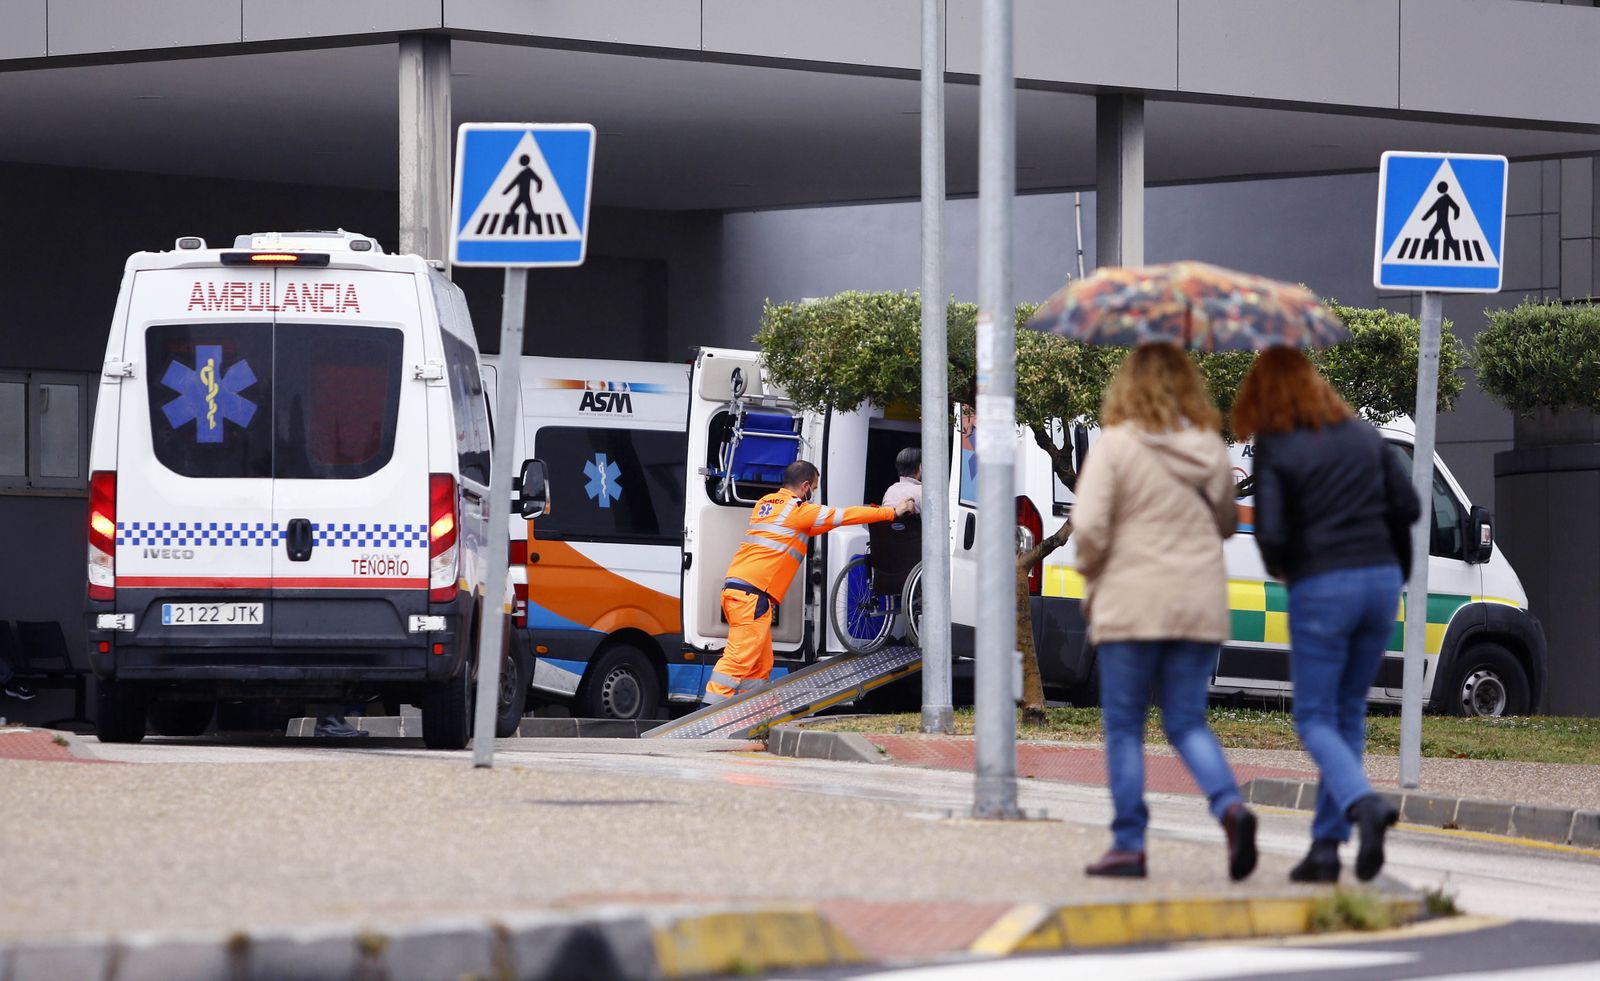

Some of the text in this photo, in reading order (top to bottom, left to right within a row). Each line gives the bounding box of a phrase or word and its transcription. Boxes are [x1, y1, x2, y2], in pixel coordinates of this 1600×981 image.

[187, 281, 361, 314] AMBULANCIA
[579, 391, 633, 413] ASM
[1241, 444, 1256, 458] AS
[143, 549, 195, 560] IVECO
[352, 559, 409, 576] TENORIO
[175, 606, 219, 623] 2122
[226, 606, 258, 622] JTK
